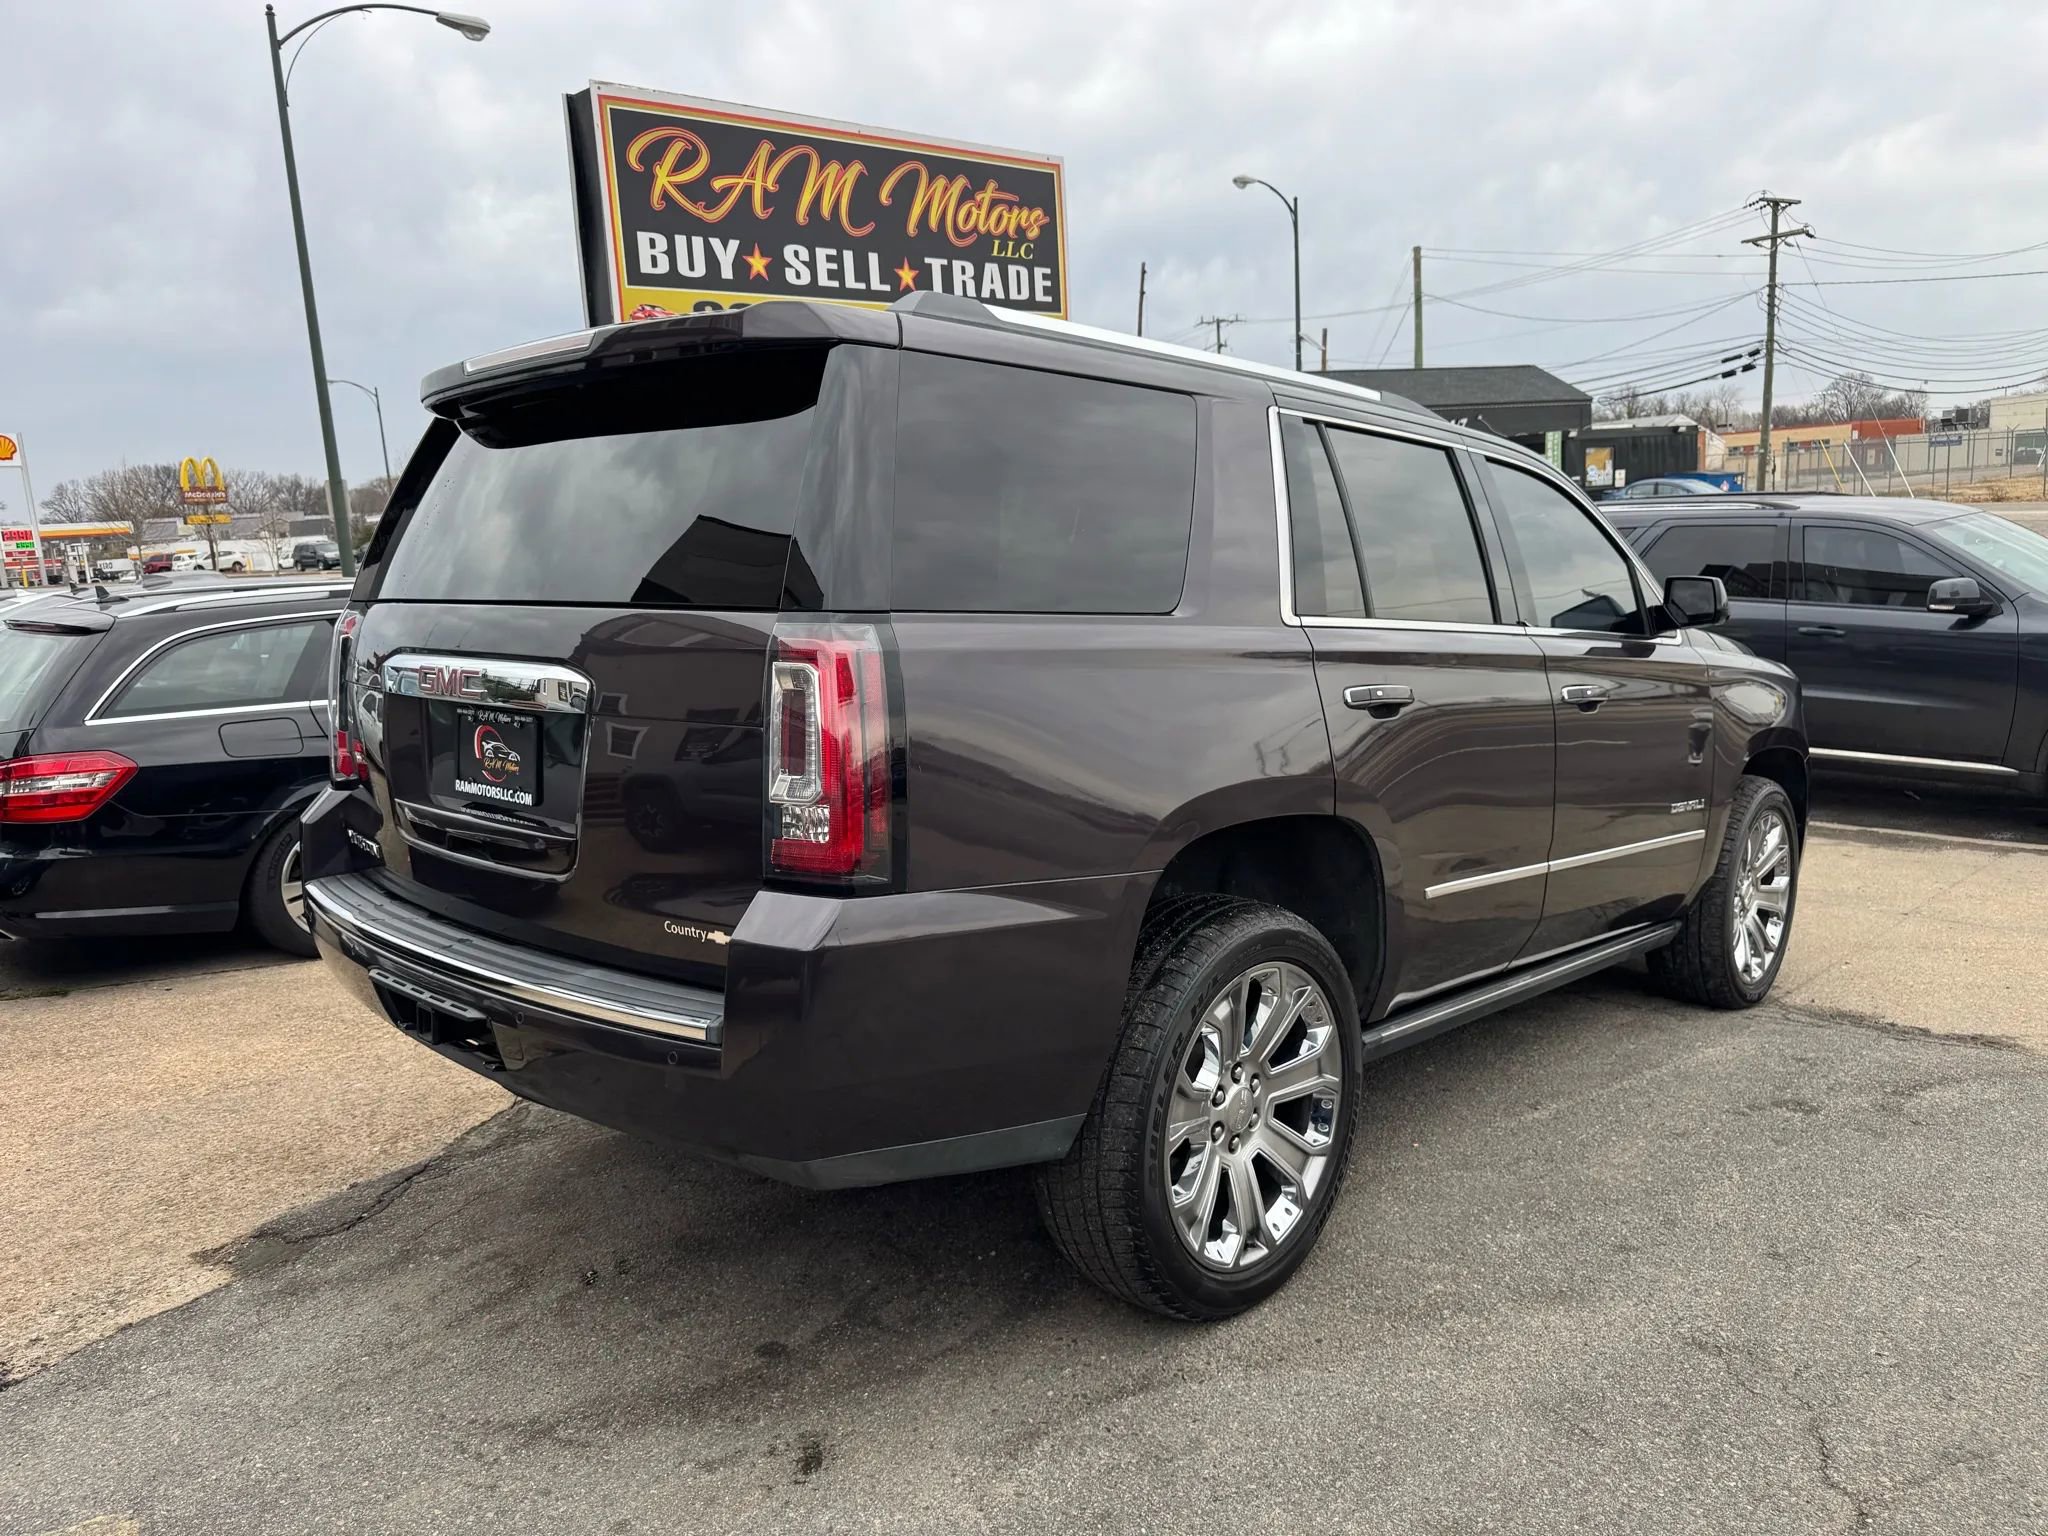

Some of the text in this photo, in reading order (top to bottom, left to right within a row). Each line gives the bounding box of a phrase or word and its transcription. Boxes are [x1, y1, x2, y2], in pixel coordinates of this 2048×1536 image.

[626, 126, 1050, 247] RAM Motors
[637, 231, 1053, 303] BUY SELL TRADE
[991, 240, 1034, 259] LLC
[418, 664, 484, 699] GMC
[664, 920, 707, 942] Country
